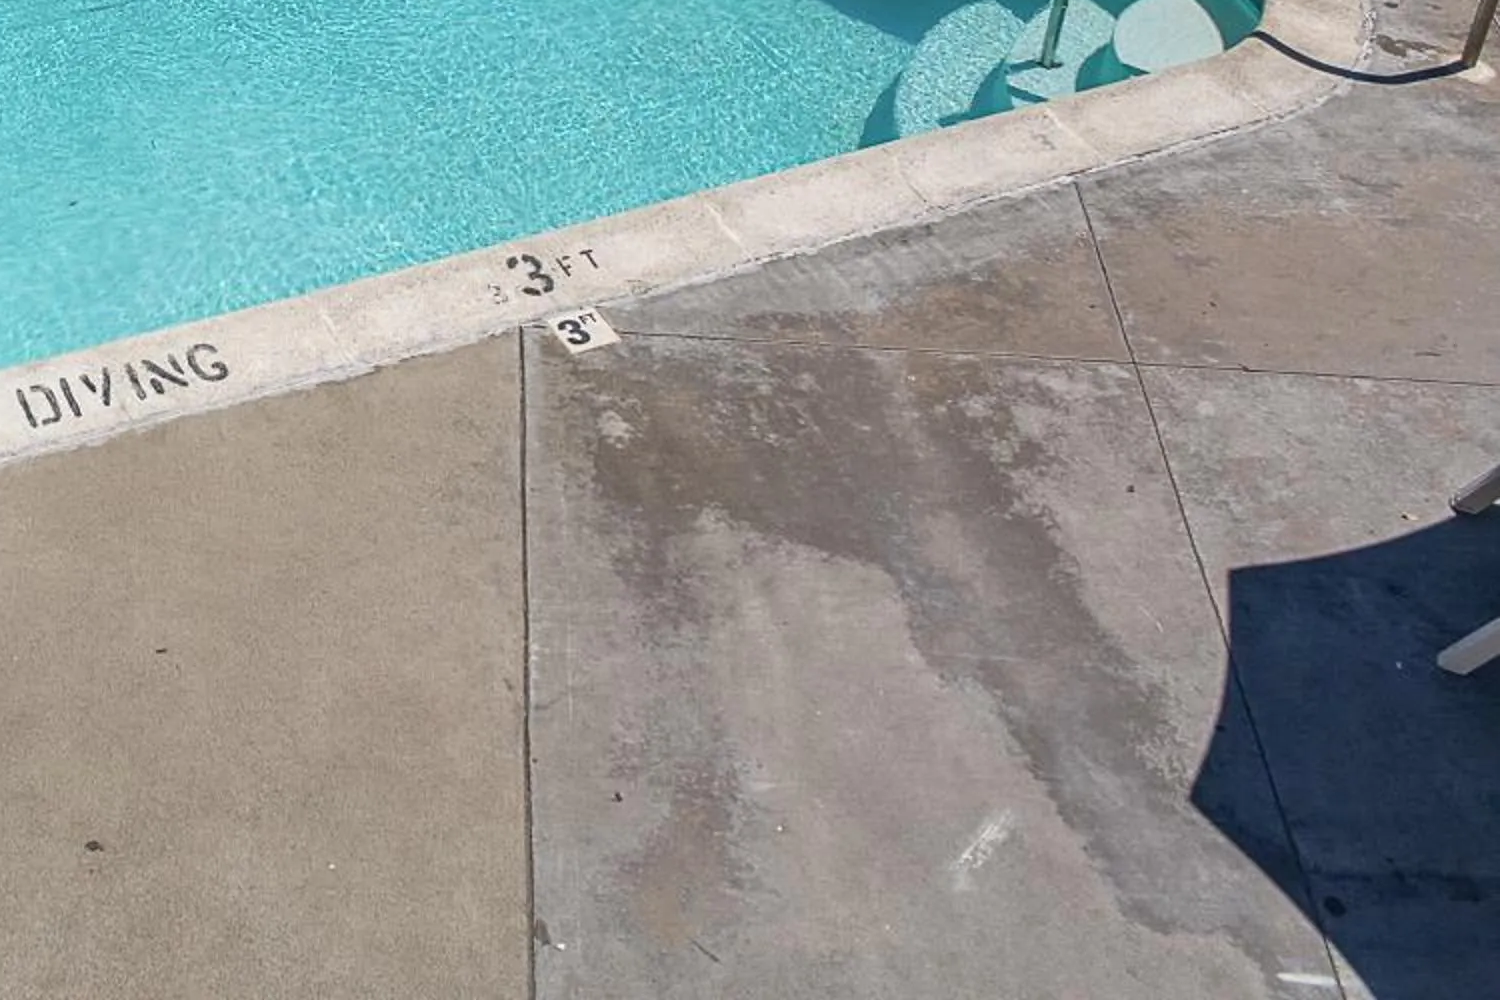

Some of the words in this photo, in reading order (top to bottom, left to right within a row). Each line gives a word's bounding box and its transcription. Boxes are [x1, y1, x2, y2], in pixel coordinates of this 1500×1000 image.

[505, 253, 555, 297] 3
[555, 250, 598, 277] FT
[556, 319, 592, 345] 3
[16, 343, 230, 428] DIVING
